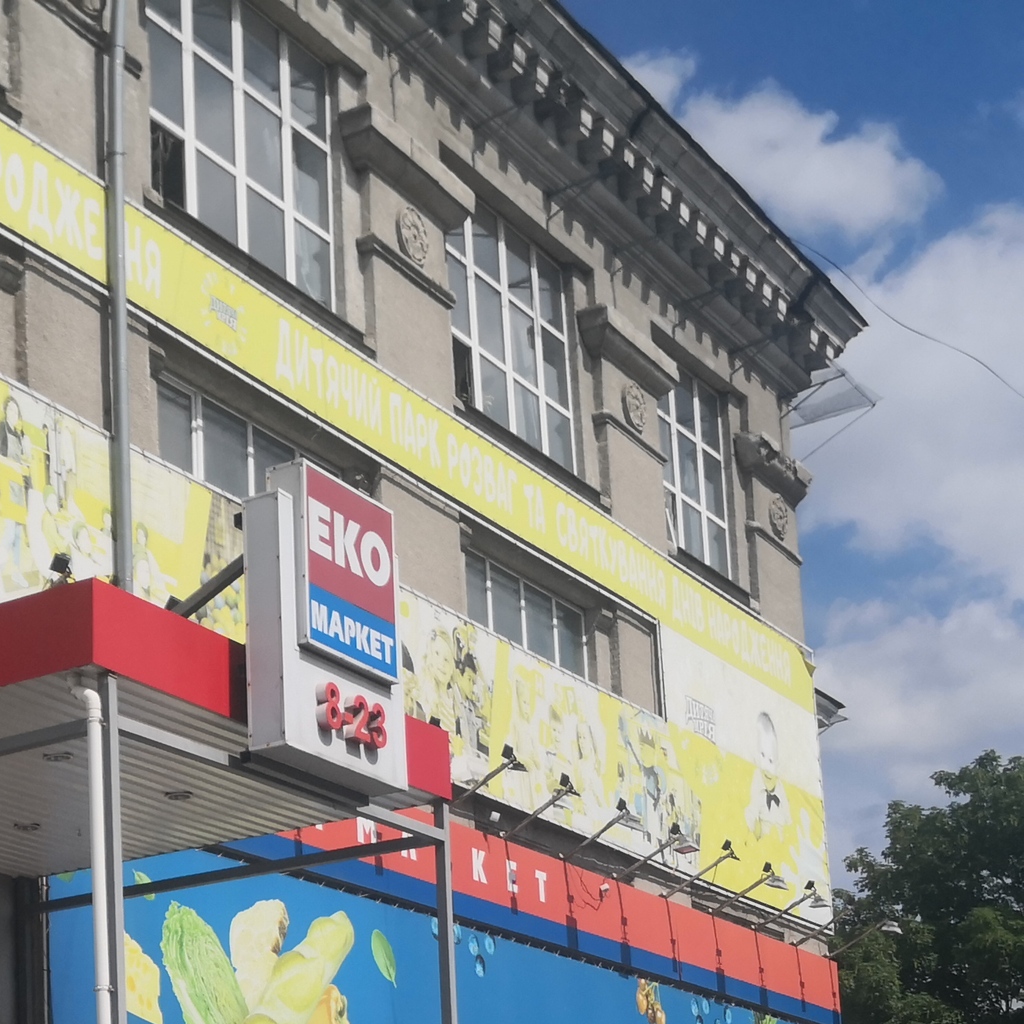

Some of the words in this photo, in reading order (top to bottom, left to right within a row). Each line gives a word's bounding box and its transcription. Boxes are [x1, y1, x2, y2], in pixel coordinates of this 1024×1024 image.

[276, 319, 382, 437] ДИТЯЧИЙ
[389, 392, 442, 469] ПАРК
[447, 433, 518, 516] РОЗВАГ
[523, 484, 546, 535] ТА
[555, 502, 667, 611] СВЯТКУВАННЯ
[672, 575, 705, 633] ДНІВ
[308, 496, 391, 587] ЕКО
[310, 599, 394, 666] МАРКЕТ
[318, 681, 388, 749] 8-23
